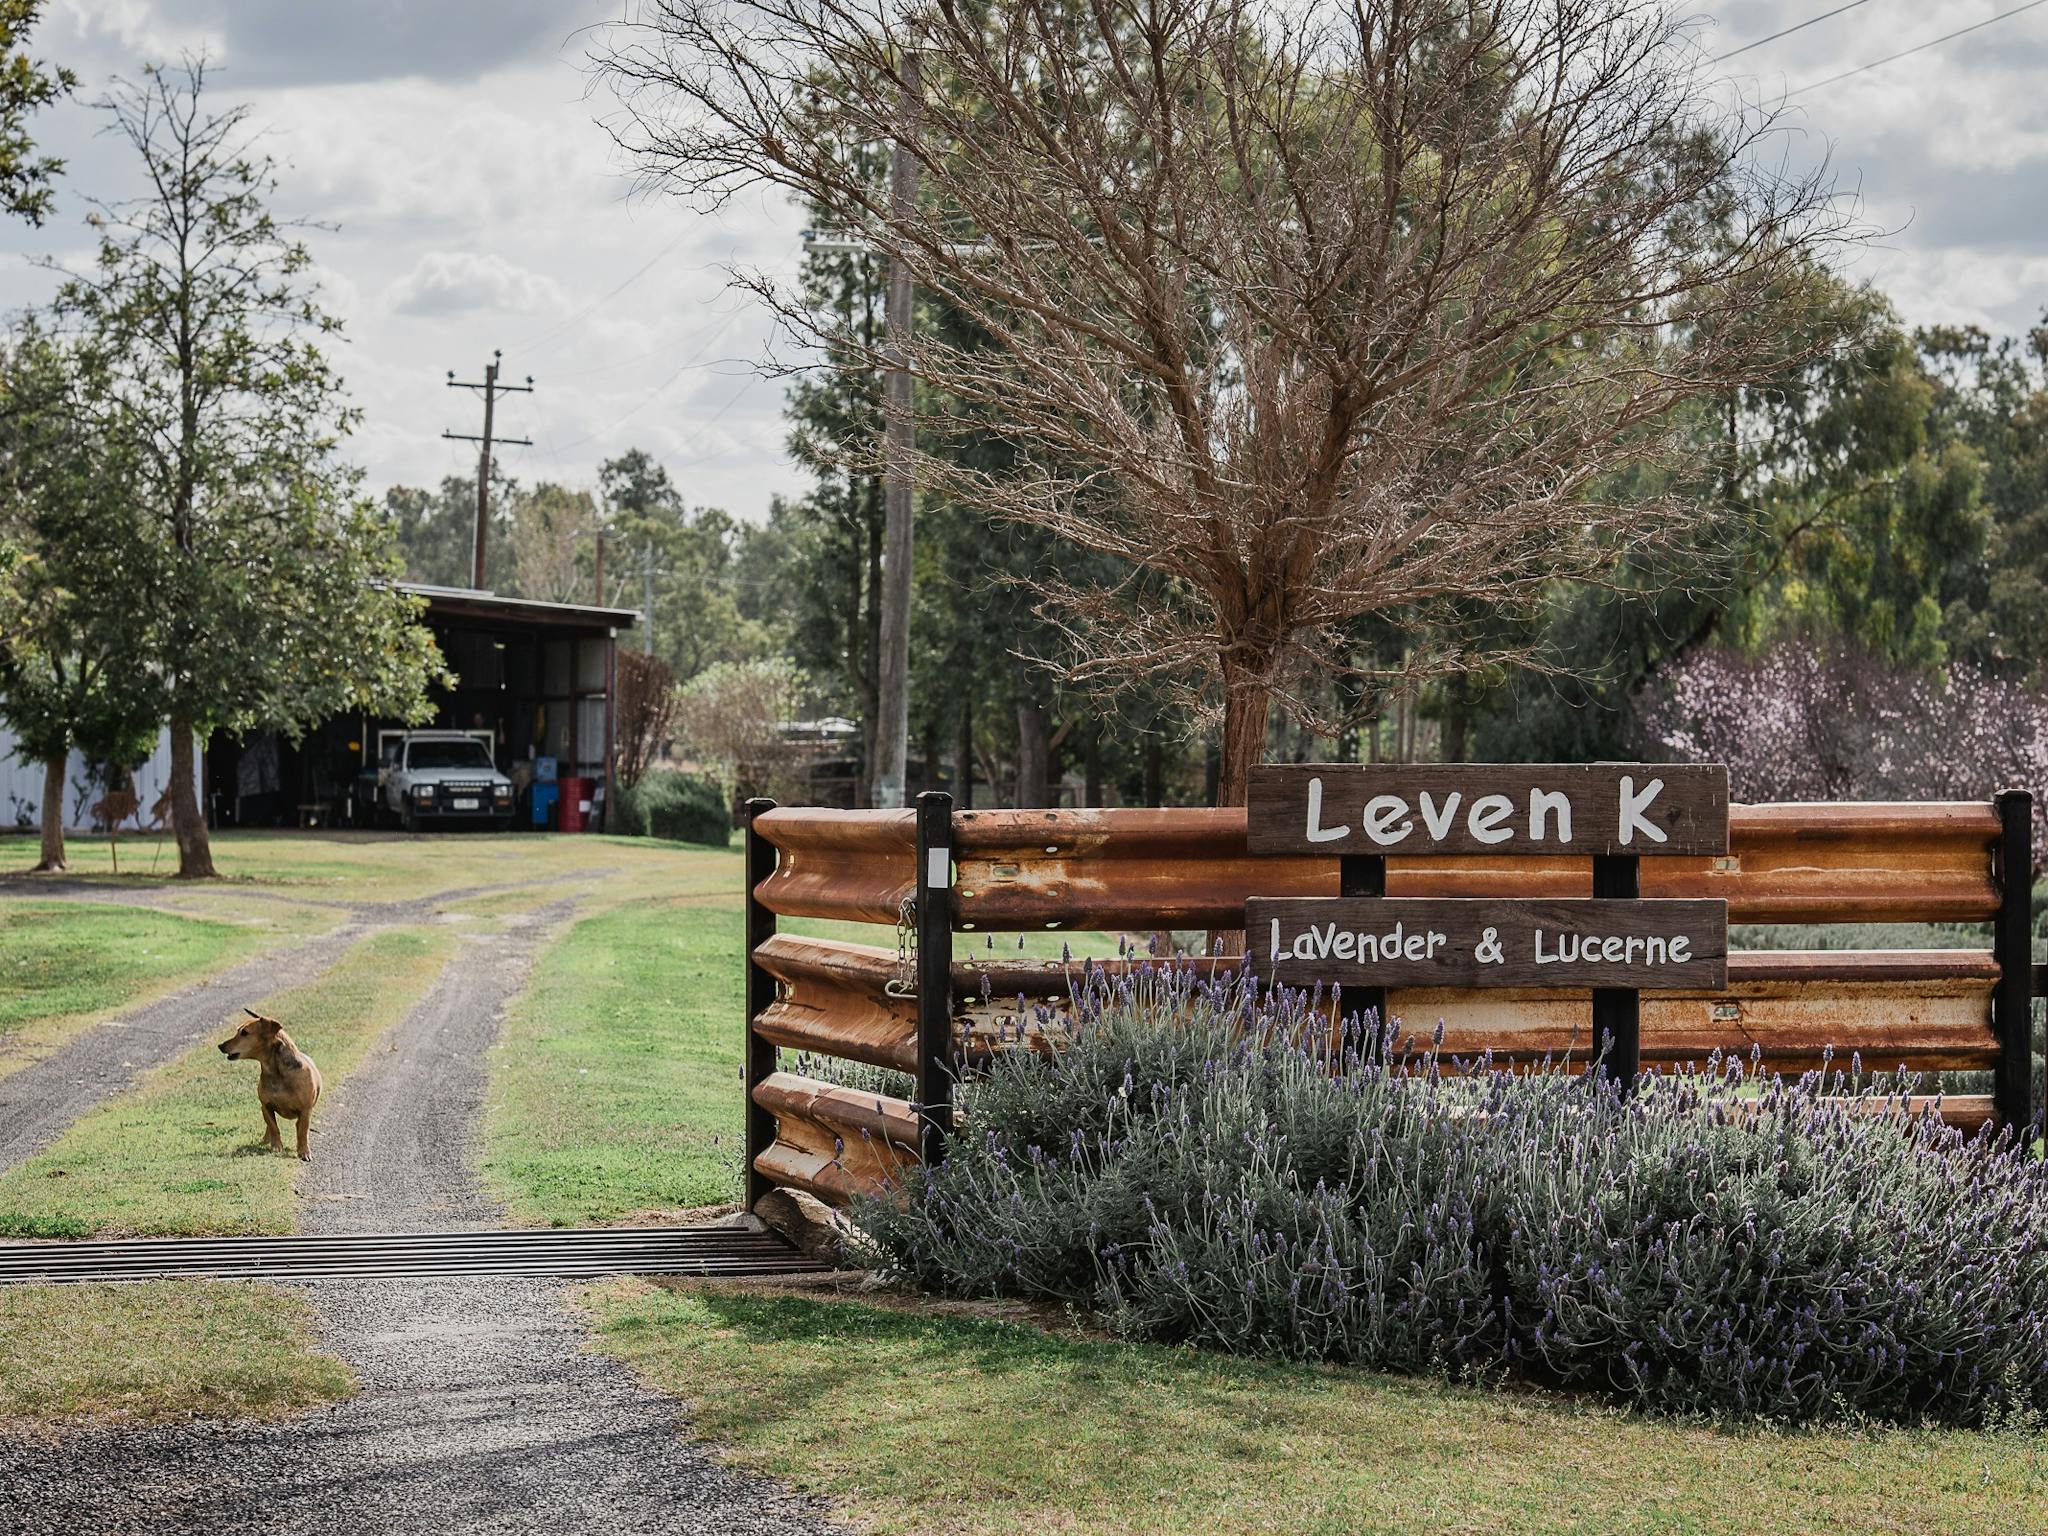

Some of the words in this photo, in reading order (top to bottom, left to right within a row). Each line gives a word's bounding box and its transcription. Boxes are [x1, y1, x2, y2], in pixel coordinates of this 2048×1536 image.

[1306, 777, 1573, 846] Leven
[1618, 775, 1668, 846] K
[1474, 926, 1505, 965] &
[1535, 929, 1693, 966] Lucerne
